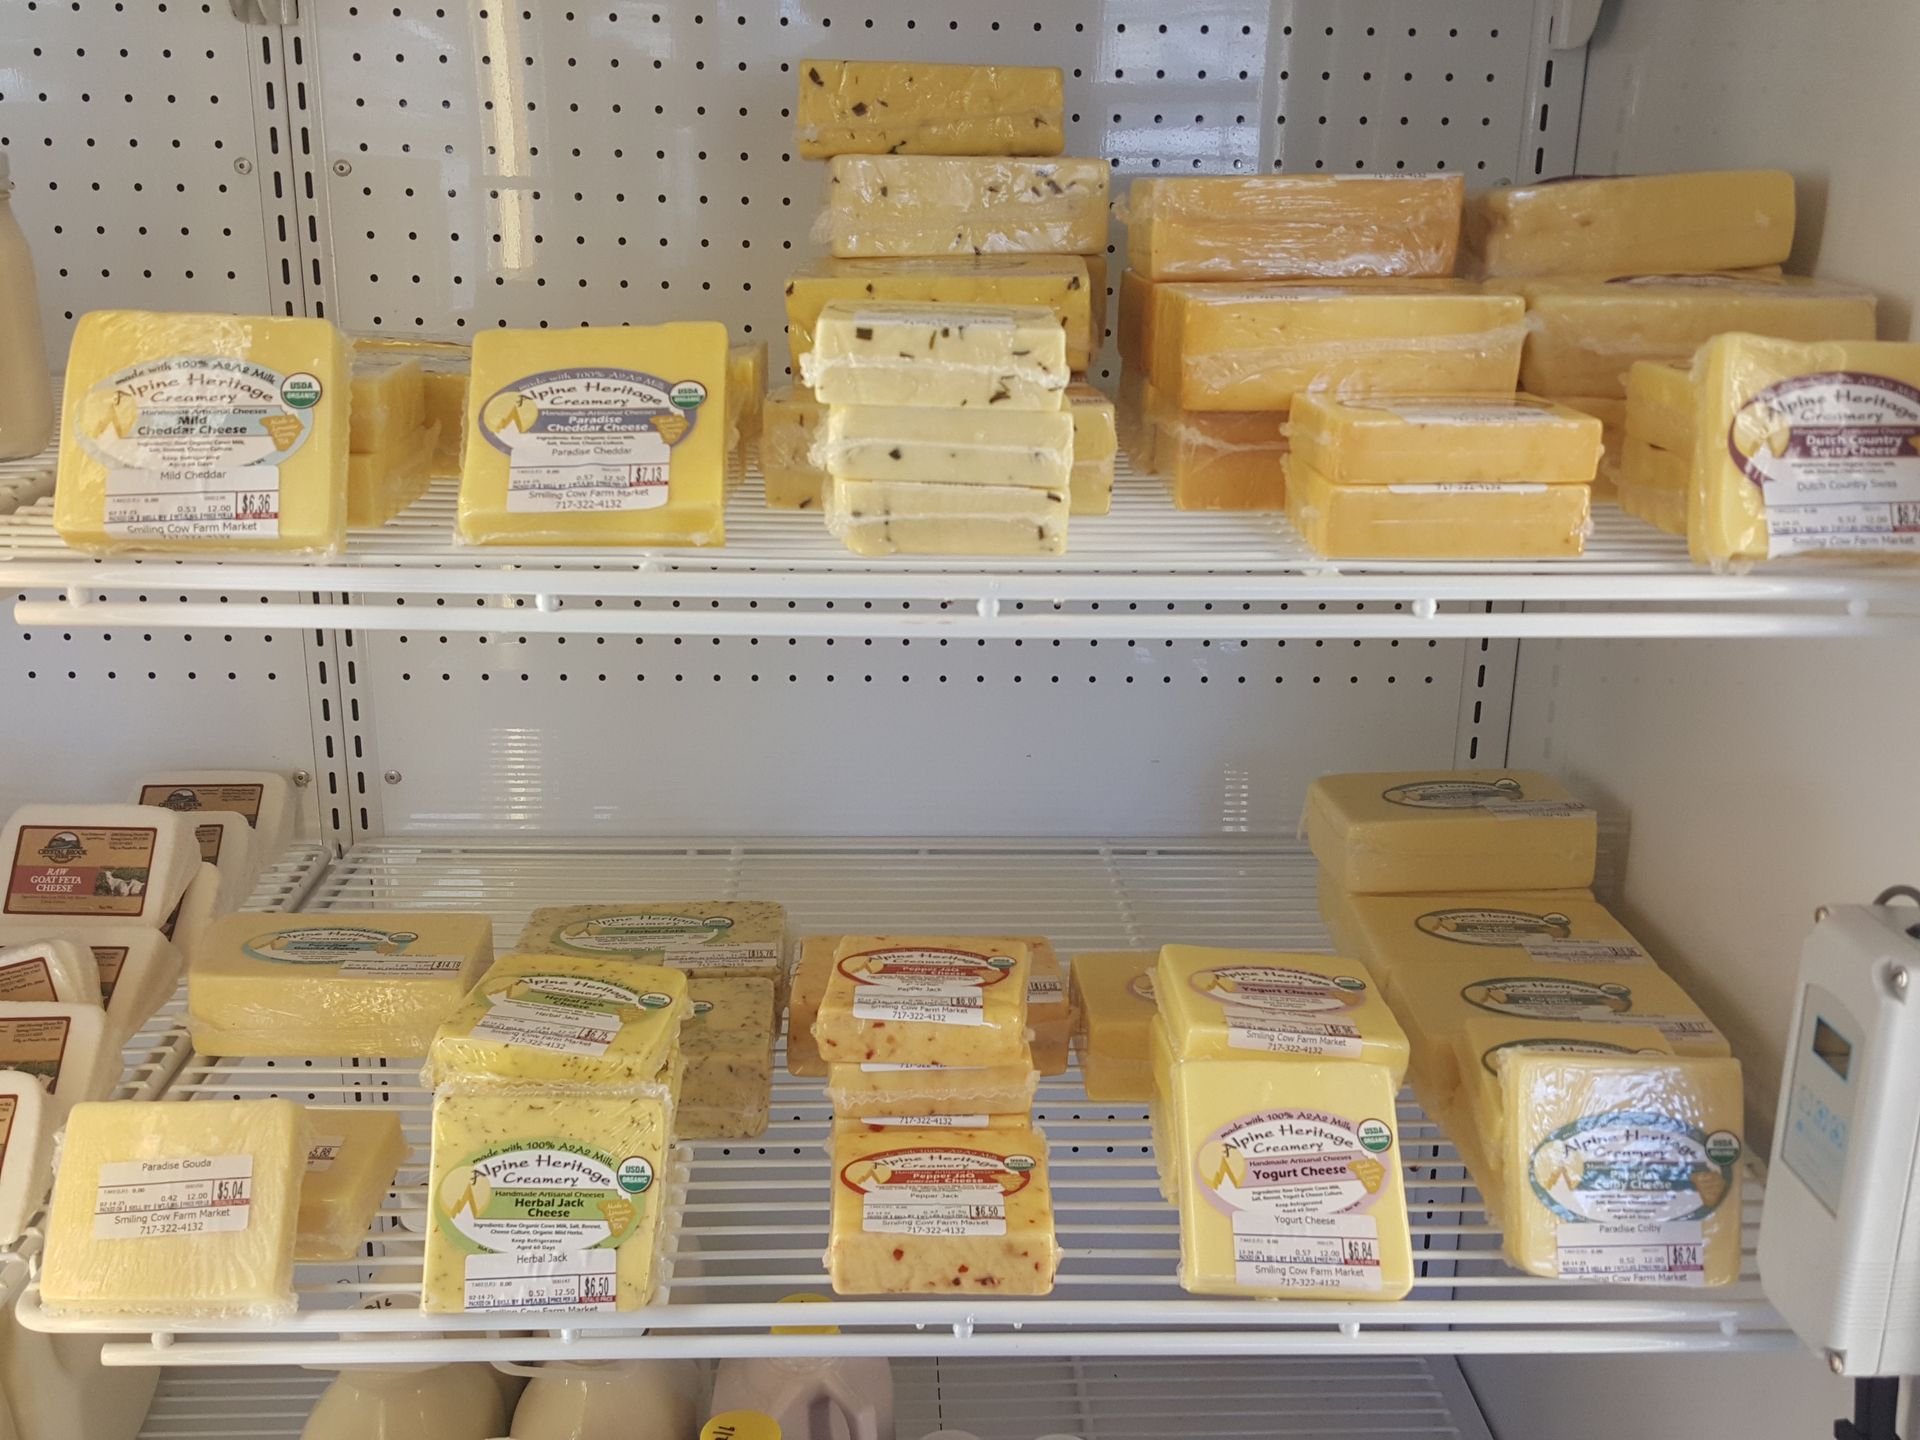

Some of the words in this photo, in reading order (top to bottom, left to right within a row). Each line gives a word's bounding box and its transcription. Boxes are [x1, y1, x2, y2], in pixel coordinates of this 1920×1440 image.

[114, 378, 179, 404] Alpine
[188, 373, 274, 402] Heritage
[290, 382, 313, 390] USDA
[150, 391, 238, 404] Creamery
[286, 392, 316, 400] ORGANIC
[517, 386, 578, 408] Alpine
[584, 381, 662, 406] Heritage
[550, 396, 630, 407] Creamery
[1834, 390, 1918, 421] Heritage
[177, 416, 208, 425] Mild
[568, 416, 623, 424] Paradise
[136, 426, 196, 436] Cheddar
[199, 425, 248, 434] Cheese
[547, 424, 601, 432] Cheddar
[604, 424, 648, 432] Cheese
[1806, 435, 1844, 446] Dutch
[1850, 435, 1903, 447] Country
[552, 448, 590, 456] Paradise
[594, 446, 632, 455] Cheddar
[1850, 446, 1898, 456] Cheese
[160, 472, 182, 480] Mild
[185, 470, 227, 480] Cheddar
[636, 466, 662, 482] $7.13
[1798, 482, 1826, 492] Dutch
[1829, 480, 1868, 490] Country
[528, 490, 564, 500] Smiling
[566, 490, 587, 498] Cow
[590, 490, 614, 498] Farm
[617, 488, 649, 497] Market
[242, 494, 271, 514] $6.36
[555, 500, 622, 509] 717-322-4132
[127, 524, 164, 534] Smiling
[168, 524, 190, 532] Cow
[193, 524, 220, 532] Farm
[222, 522, 258, 532] Market
[46, 868, 69, 876] RAW
[30, 876, 58, 884] GOAT
[58, 876, 82, 884] FETA
[36, 884, 74, 892] CHEESE
[1242, 986, 1282, 995] Yogurt
[942, 1006, 968, 1014] Market
[892, 1010, 946, 1022] 717-322-4132
[509, 1036, 566, 1050] 717-322-4132
[1246, 1030, 1275, 1041] Smiling
[1277, 1033, 1294, 1042] Cow
[1296, 1034, 1318, 1043] Farm
[1319, 1036, 1347, 1046] Market
[1267, 1042, 1324, 1054] 717-322-4132
[900, 1116, 952, 1125] 717-322-4132
[1220, 1122, 1243, 1138] made
[1244, 1114, 1264, 1126] with
[1267, 1112, 1294, 1120] 100%
[1296, 1112, 1329, 1124] A2A2
[1330, 1116, 1352, 1132] Milk
[1364, 1127, 1384, 1135] USDA
[1222, 1130, 1276, 1157] Alpine
[1278, 1124, 1354, 1148] Heritage
[1562, 1137, 1619, 1158] Alpine
[1623, 1129, 1698, 1160] Heritage
[1712, 1139, 1732, 1148] USDA
[1253, 1142, 1324, 1154] Creamery
[472, 1148, 499, 1164] made
[502, 1142, 522, 1154] with
[526, 1141, 556, 1150] 100%
[557, 1142, 591, 1155] A2A2
[592, 1151, 614, 1168] Milk
[1323, 1154, 1352, 1162] Cheeses
[1594, 1148, 1668, 1161] Creamery
[142, 1162, 180, 1172] Paradise
[182, 1160, 212, 1169] Gouda
[873, 1156, 923, 1170] Alpine
[930, 1155, 999, 1168] Heritage
[901, 1162, 970, 1170] Creamery
[470, 1158, 530, 1186] Alpine
[535, 1154, 612, 1186] Heritage
[625, 1165, 646, 1174] USDA
[1252, 1168, 1300, 1182] Yogurt
[1300, 1164, 1347, 1178] Cheese
[502, 1171, 580, 1186] Creamery
[621, 1176, 648, 1184] ORGANIC
[217, 1181, 244, 1200] $5.04
[494, 1190, 536, 1198] Handmade
[538, 1190, 573, 1198] Artisanal
[574, 1190, 605, 1198] Cheeses
[160, 1194, 178, 1202] 0.42
[187, 1192, 208, 1200] 12.00
[514, 1198, 555, 1208] Herbal
[557, 1198, 584, 1208] Jack
[114, 1214, 148, 1225] Smiling
[150, 1212, 171, 1222] Cow
[173, 1211, 197, 1221] Farm
[199, 1208, 230, 1219] Market
[528, 1208, 570, 1218] Cheese
[975, 1206, 998, 1217] $6.50
[1274, 1216, 1303, 1224] Yogurt
[1305, 1216, 1336, 1225] Cheese
[140, 1222, 204, 1235] 717-322-4132
[906, 1226, 966, 1235] 717-322-4132
[1600, 1224, 1635, 1233] Paradise
[1638, 1224, 1661, 1234] Colby
[1348, 1241, 1372, 1260] $6.84
[1673, 1246, 1696, 1265] $6.24
[516, 1254, 546, 1264] Herbal
[548, 1253, 568, 1263] Jack
[1255, 1265, 1286, 1276] Smiling
[1288, 1266, 1308, 1276] Cow
[1310, 1266, 1332, 1276] Farm
[1334, 1267, 1364, 1276] Market
[584, 1276, 610, 1298] $6.50
[1280, 1278, 1340, 1287] 717-322-4132
[554, 1288, 576, 1296] 12.50
